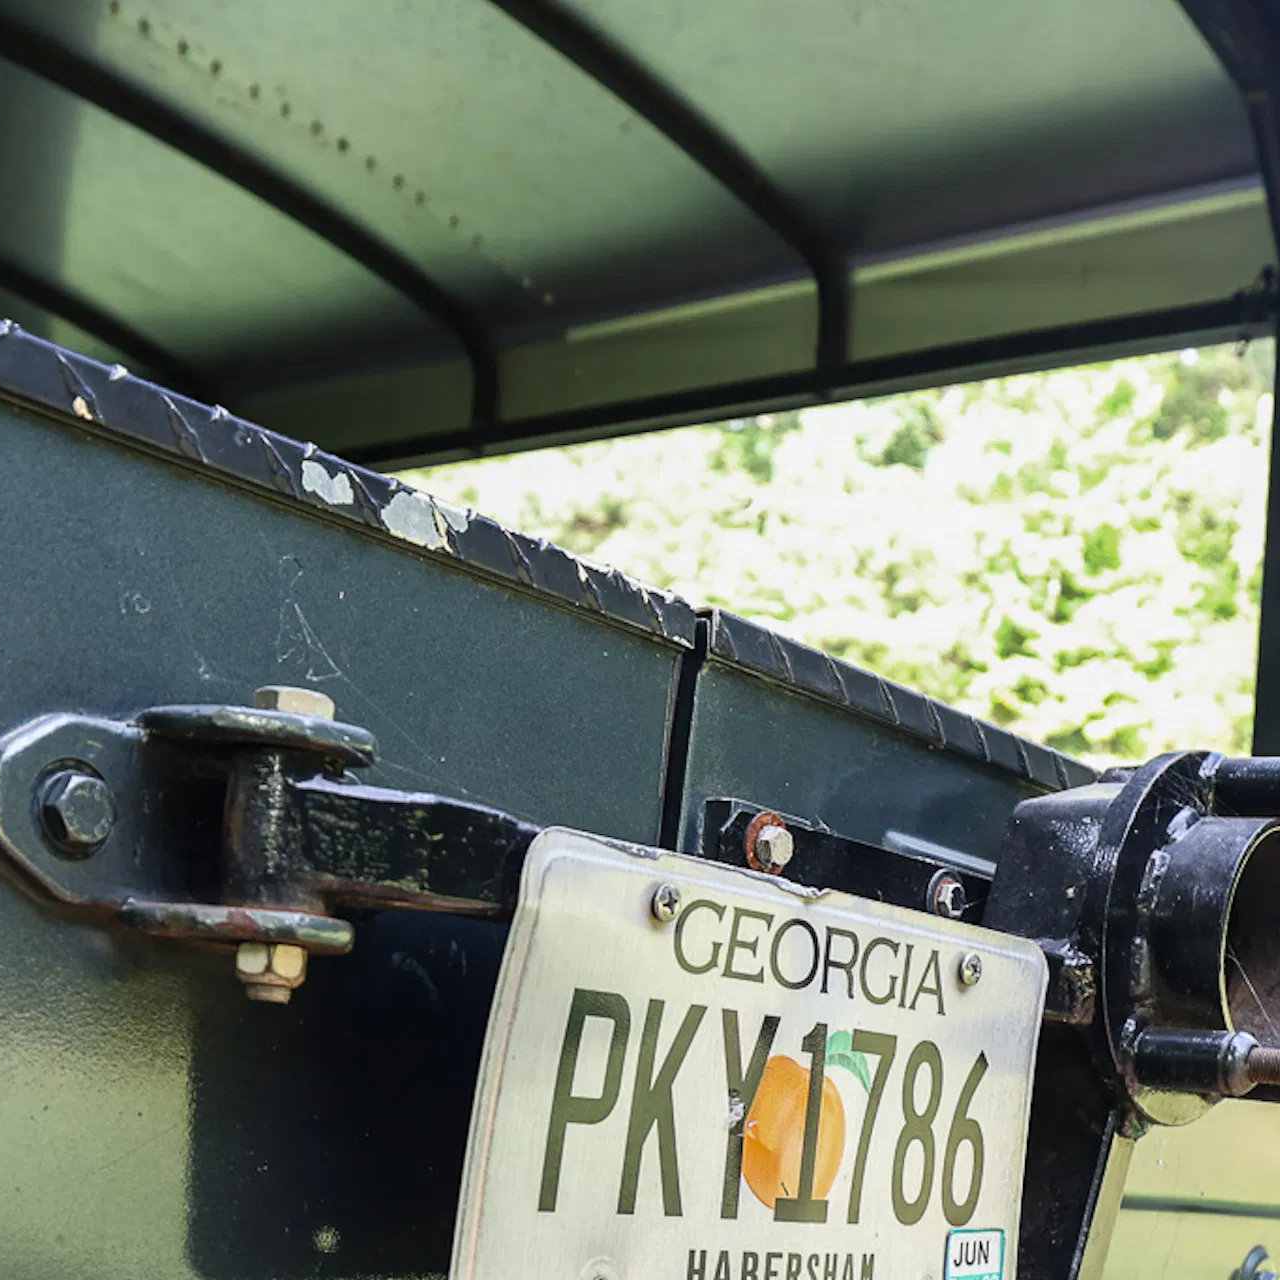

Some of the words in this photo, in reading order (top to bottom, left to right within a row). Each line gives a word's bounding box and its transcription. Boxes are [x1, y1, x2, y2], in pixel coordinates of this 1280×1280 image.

[674, 899, 946, 1016] GEORGIA
[538, 987, 989, 1226] PKY1786
[953, 1240, 989, 1267] JUN
